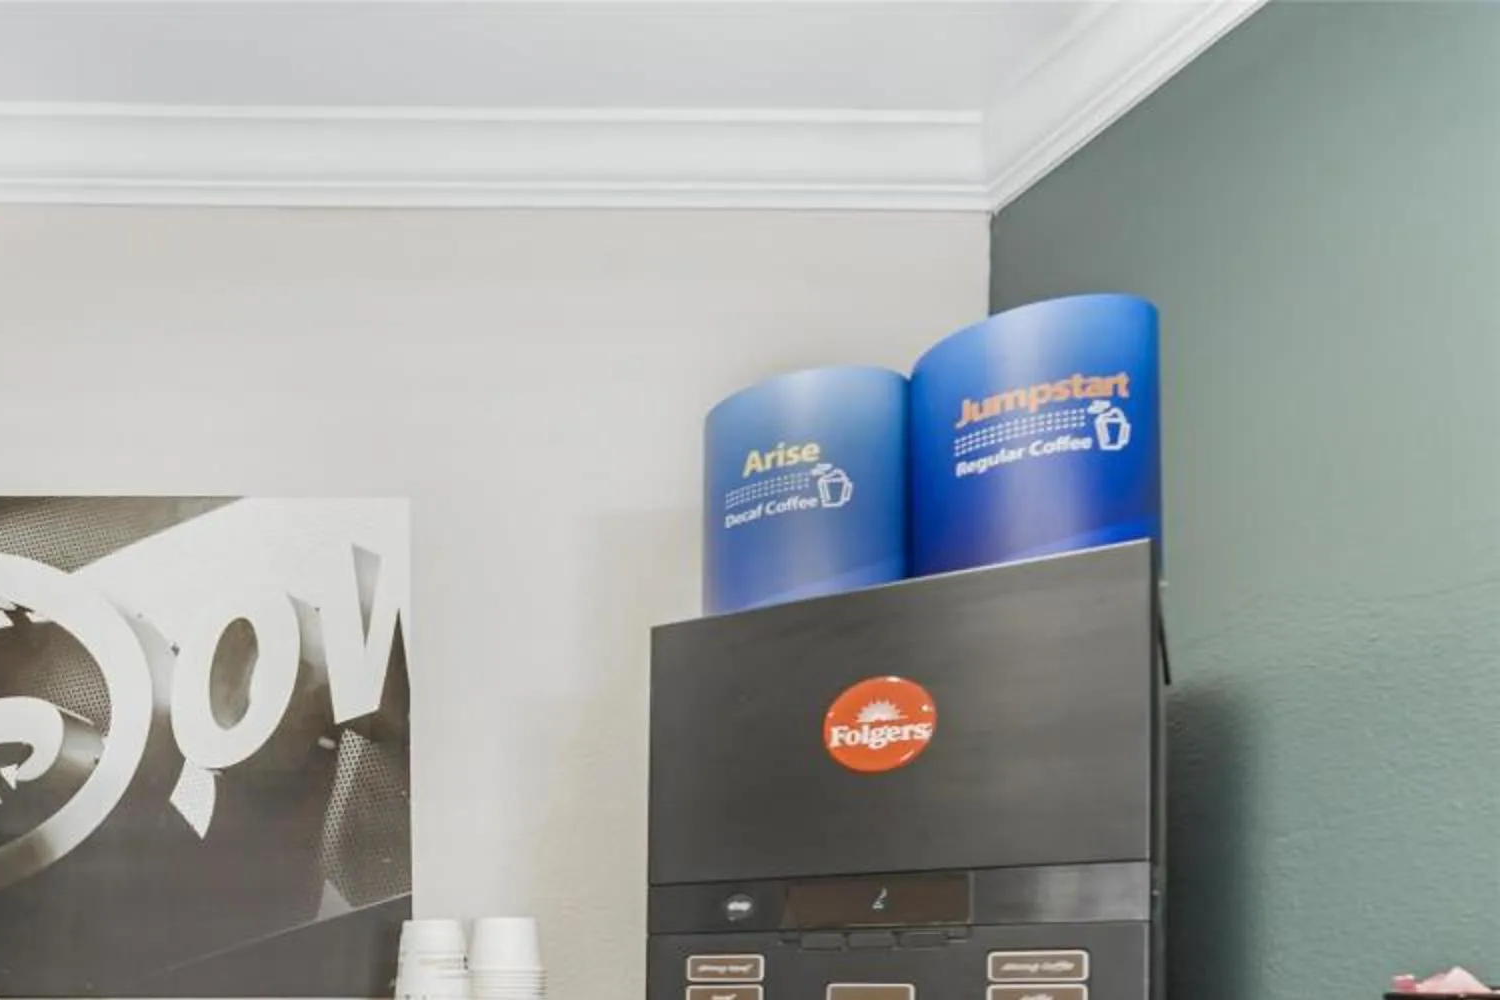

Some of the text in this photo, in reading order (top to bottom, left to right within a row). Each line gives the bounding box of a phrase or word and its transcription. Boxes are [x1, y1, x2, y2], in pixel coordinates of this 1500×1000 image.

[955, 371, 1130, 430] Jumpstart
[742, 441, 821, 479] Arise
[955, 434, 1093, 478] Regular Coffee
[724, 495, 819, 529] Decaf Coffee
[829, 722, 933, 750] Folgers
